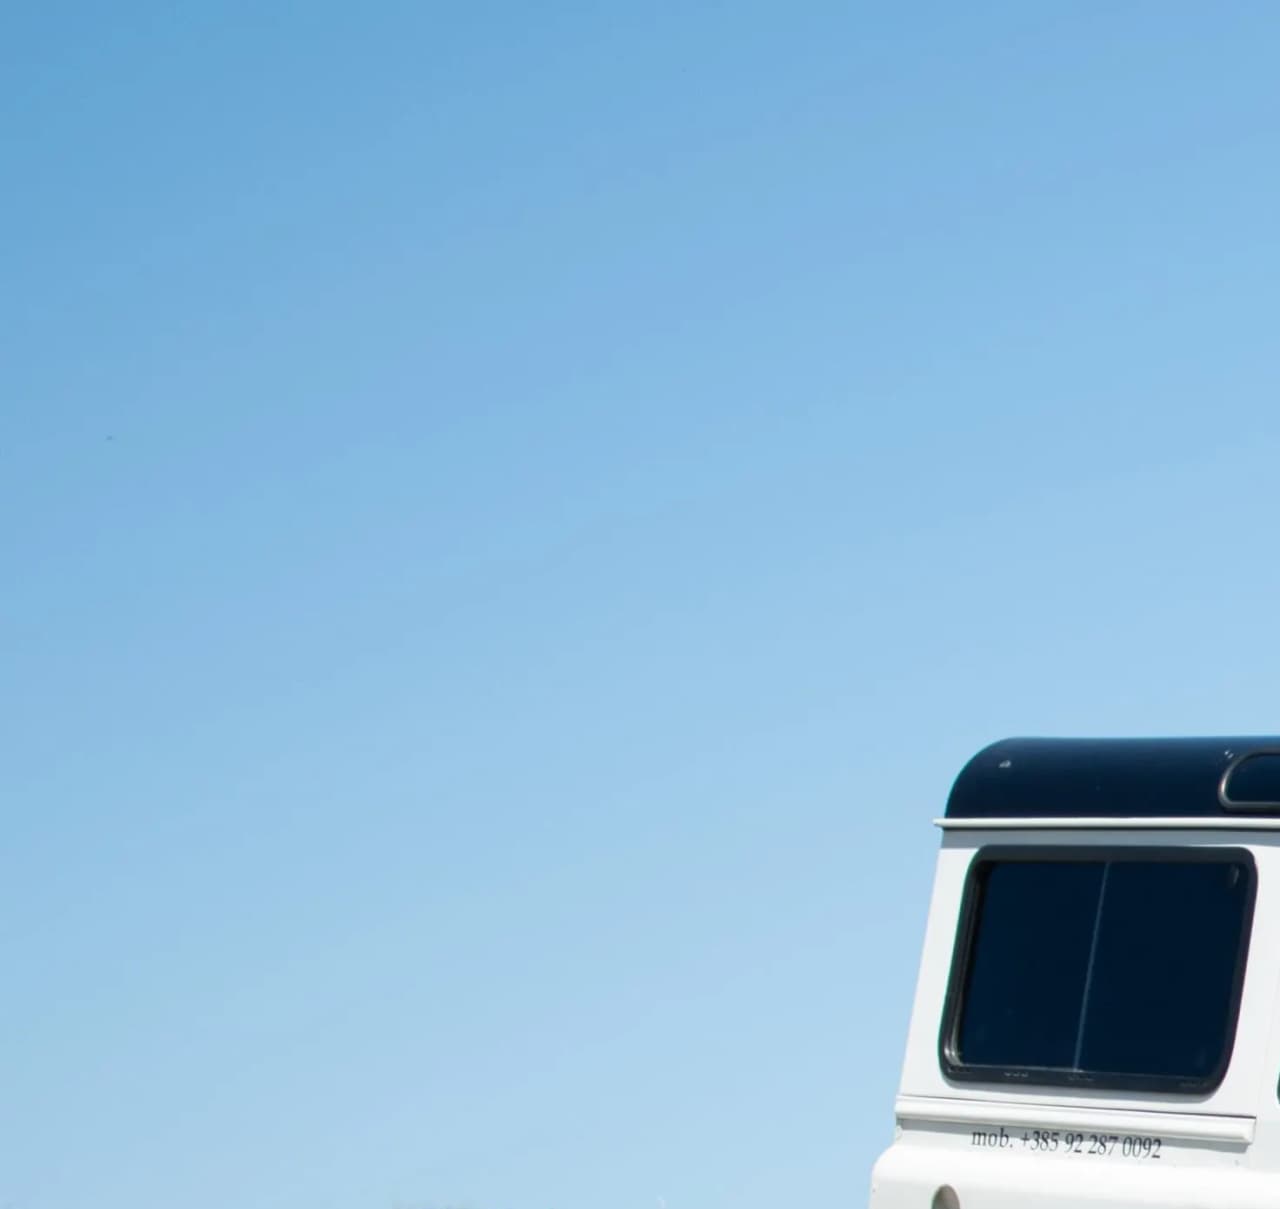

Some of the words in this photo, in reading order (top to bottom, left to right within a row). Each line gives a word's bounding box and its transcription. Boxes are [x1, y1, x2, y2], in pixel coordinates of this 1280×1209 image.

[971, 1128, 1013, 1148] mob.
[1021, 1130, 1060, 1152] +385
[1065, 1132, 1084, 1153] 92
[1088, 1134, 1119, 1156] 287
[1122, 1136, 1162, 1159] 0092
